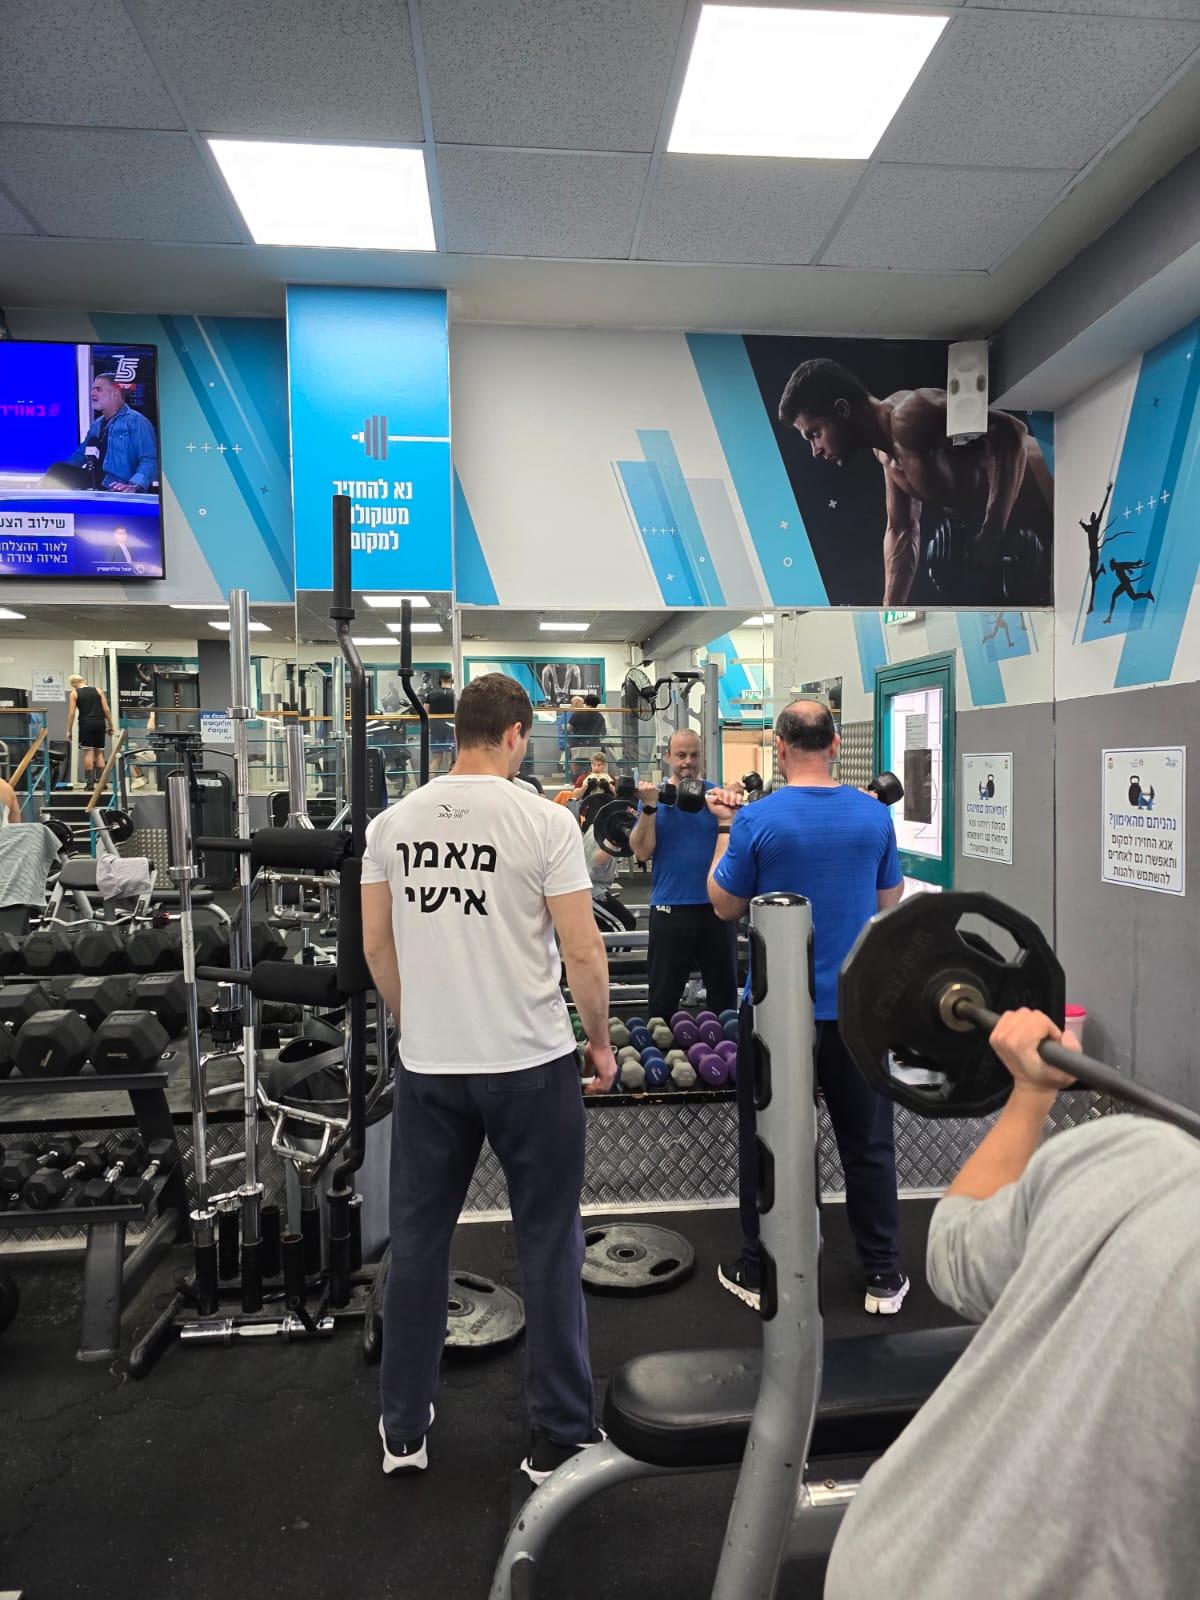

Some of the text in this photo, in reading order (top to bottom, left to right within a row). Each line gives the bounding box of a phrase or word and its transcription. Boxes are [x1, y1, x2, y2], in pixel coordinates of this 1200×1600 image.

[332, 478, 413, 500] נא להחזיר
[28, 515, 66, 529] שילוב
[351, 504, 410, 528] משקולו
[0, 539, 68, 552] לאור ההצלח
[351, 530, 399, 554] למקום
[7, 553, 33, 563] צורה
[36, 553, 68, 564] באיזה
[1108, 812, 1177, 831] נהניתם מהאימון?
[1111, 833, 1174, 851] אנא החזירו למקום
[396, 841, 497, 877] מאמן
[1107, 849, 1177, 869] ותאפשרו גם לאחרים
[1112, 865, 1171, 885] להשתמש ולהנות
[404, 886, 489, 916] אישי
